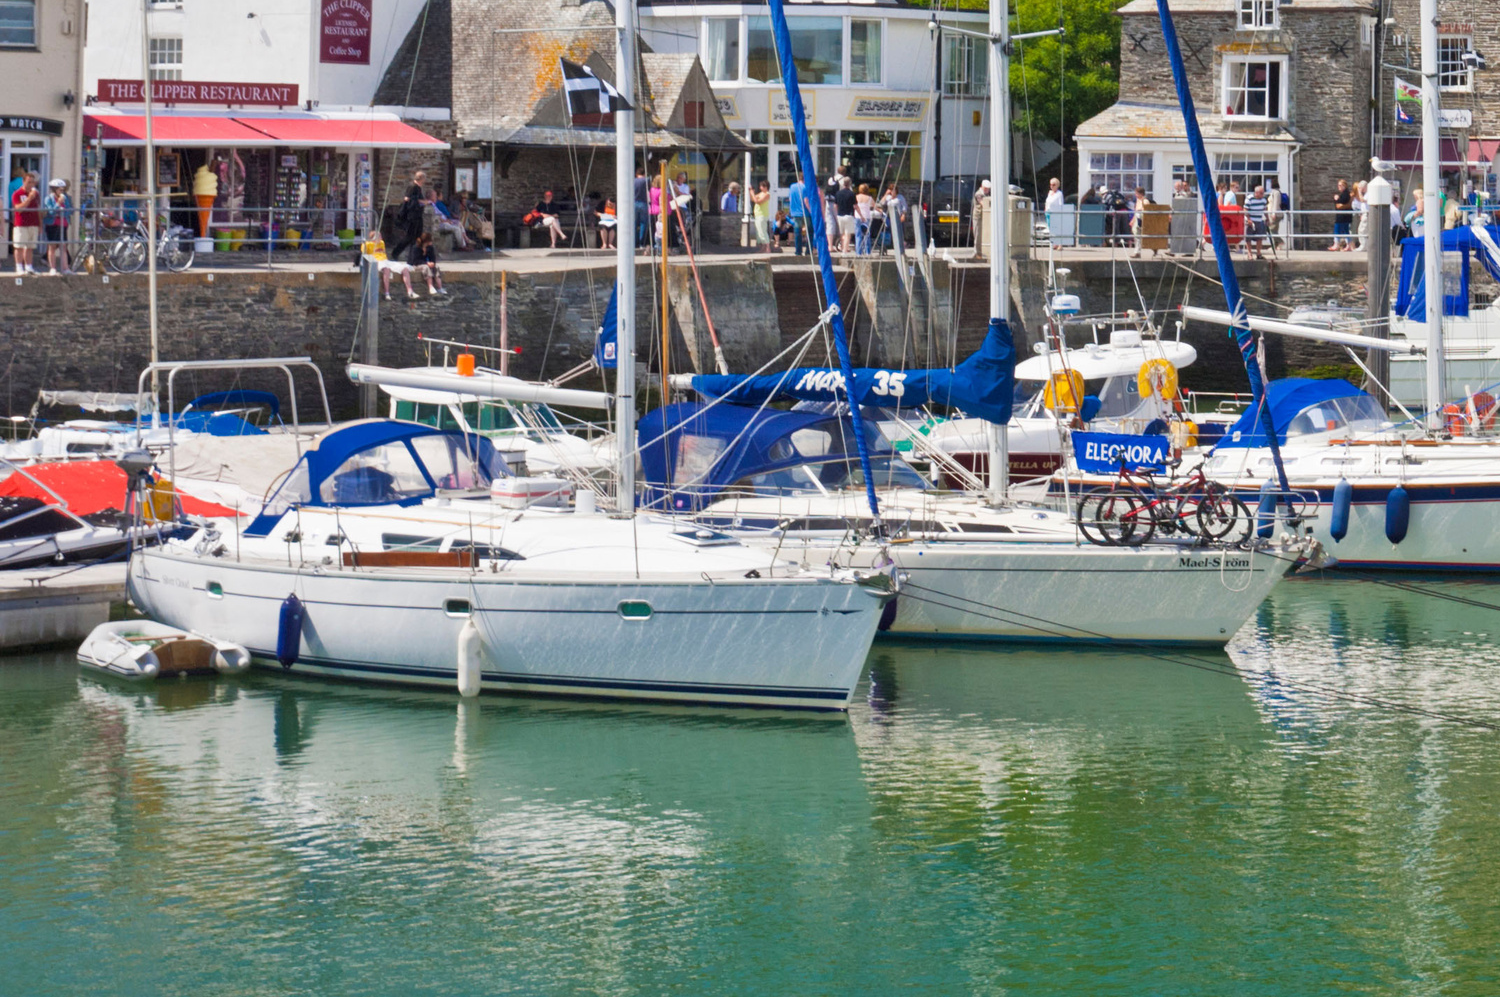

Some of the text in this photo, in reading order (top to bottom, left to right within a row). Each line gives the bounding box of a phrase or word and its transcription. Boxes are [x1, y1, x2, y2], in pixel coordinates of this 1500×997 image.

[323, 0, 339, 17] THE
[324, 26, 369, 36] RESTAURANT
[108, 84, 138, 98] THE
[200, 85, 291, 102] RESTAURANT
[10, 118, 43, 130] WATCH
[795, 370, 907, 396] MAX 35
[1085, 442, 1164, 465] ELEONORA
[1008, 461, 1038, 469] TELLA
[1179, 557, 1250, 568] Mael-Sröm
